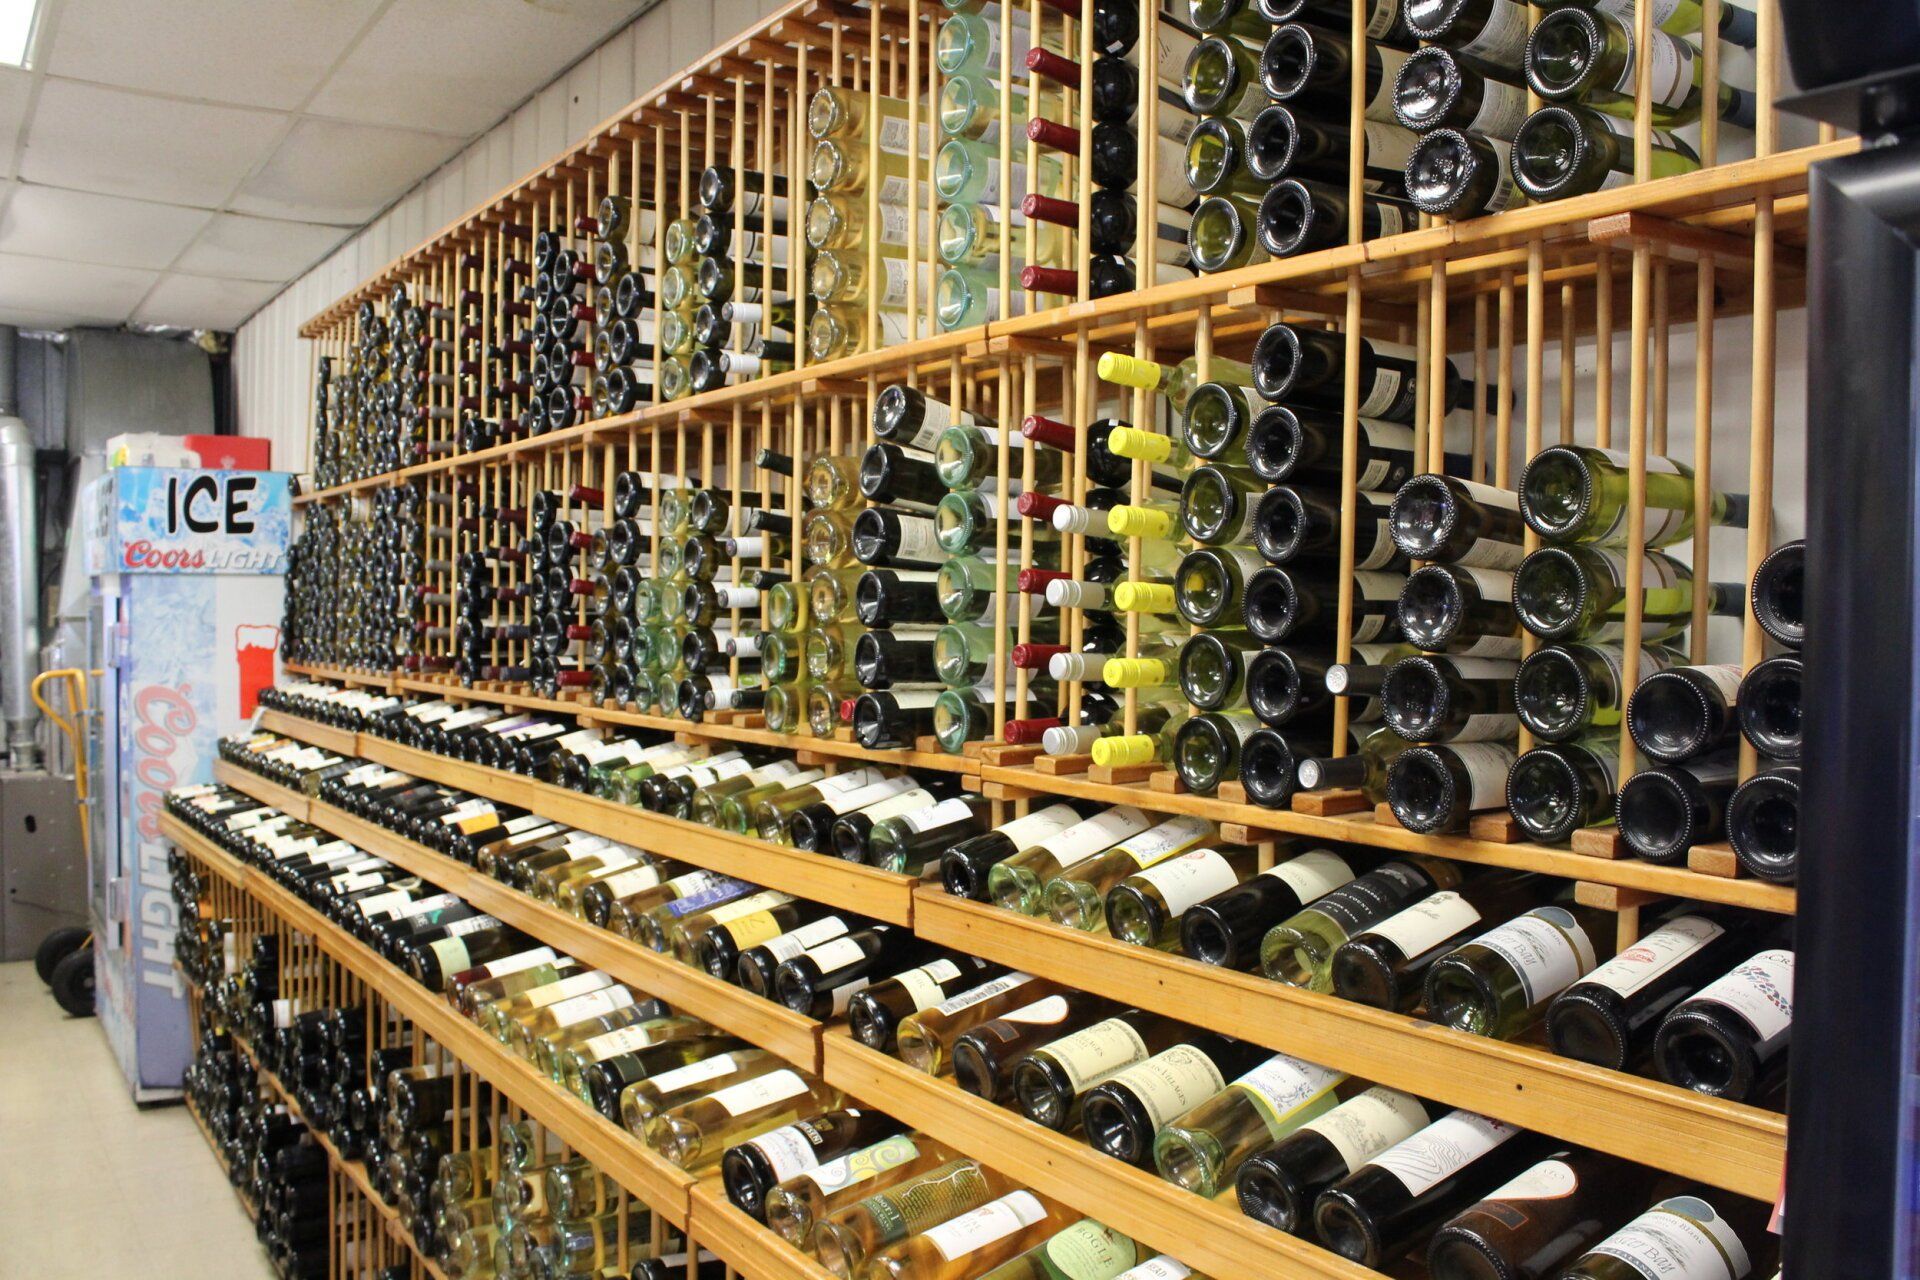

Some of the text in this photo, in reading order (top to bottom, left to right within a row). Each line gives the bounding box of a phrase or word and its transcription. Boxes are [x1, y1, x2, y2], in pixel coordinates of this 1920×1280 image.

[168, 475, 257, 534] ICE
[124, 540, 288, 570] Coors LIGHT
[135, 683, 198, 999] Coors LIGHT
[1514, 943, 1537, 966] Bay
[1162, 1066, 1187, 1107] VILLAGES
[1075, 1226, 1114, 1269] BOGLE
[1679, 1222, 1707, 1246] Blanc
[1643, 1246, 1676, 1275] Bay
